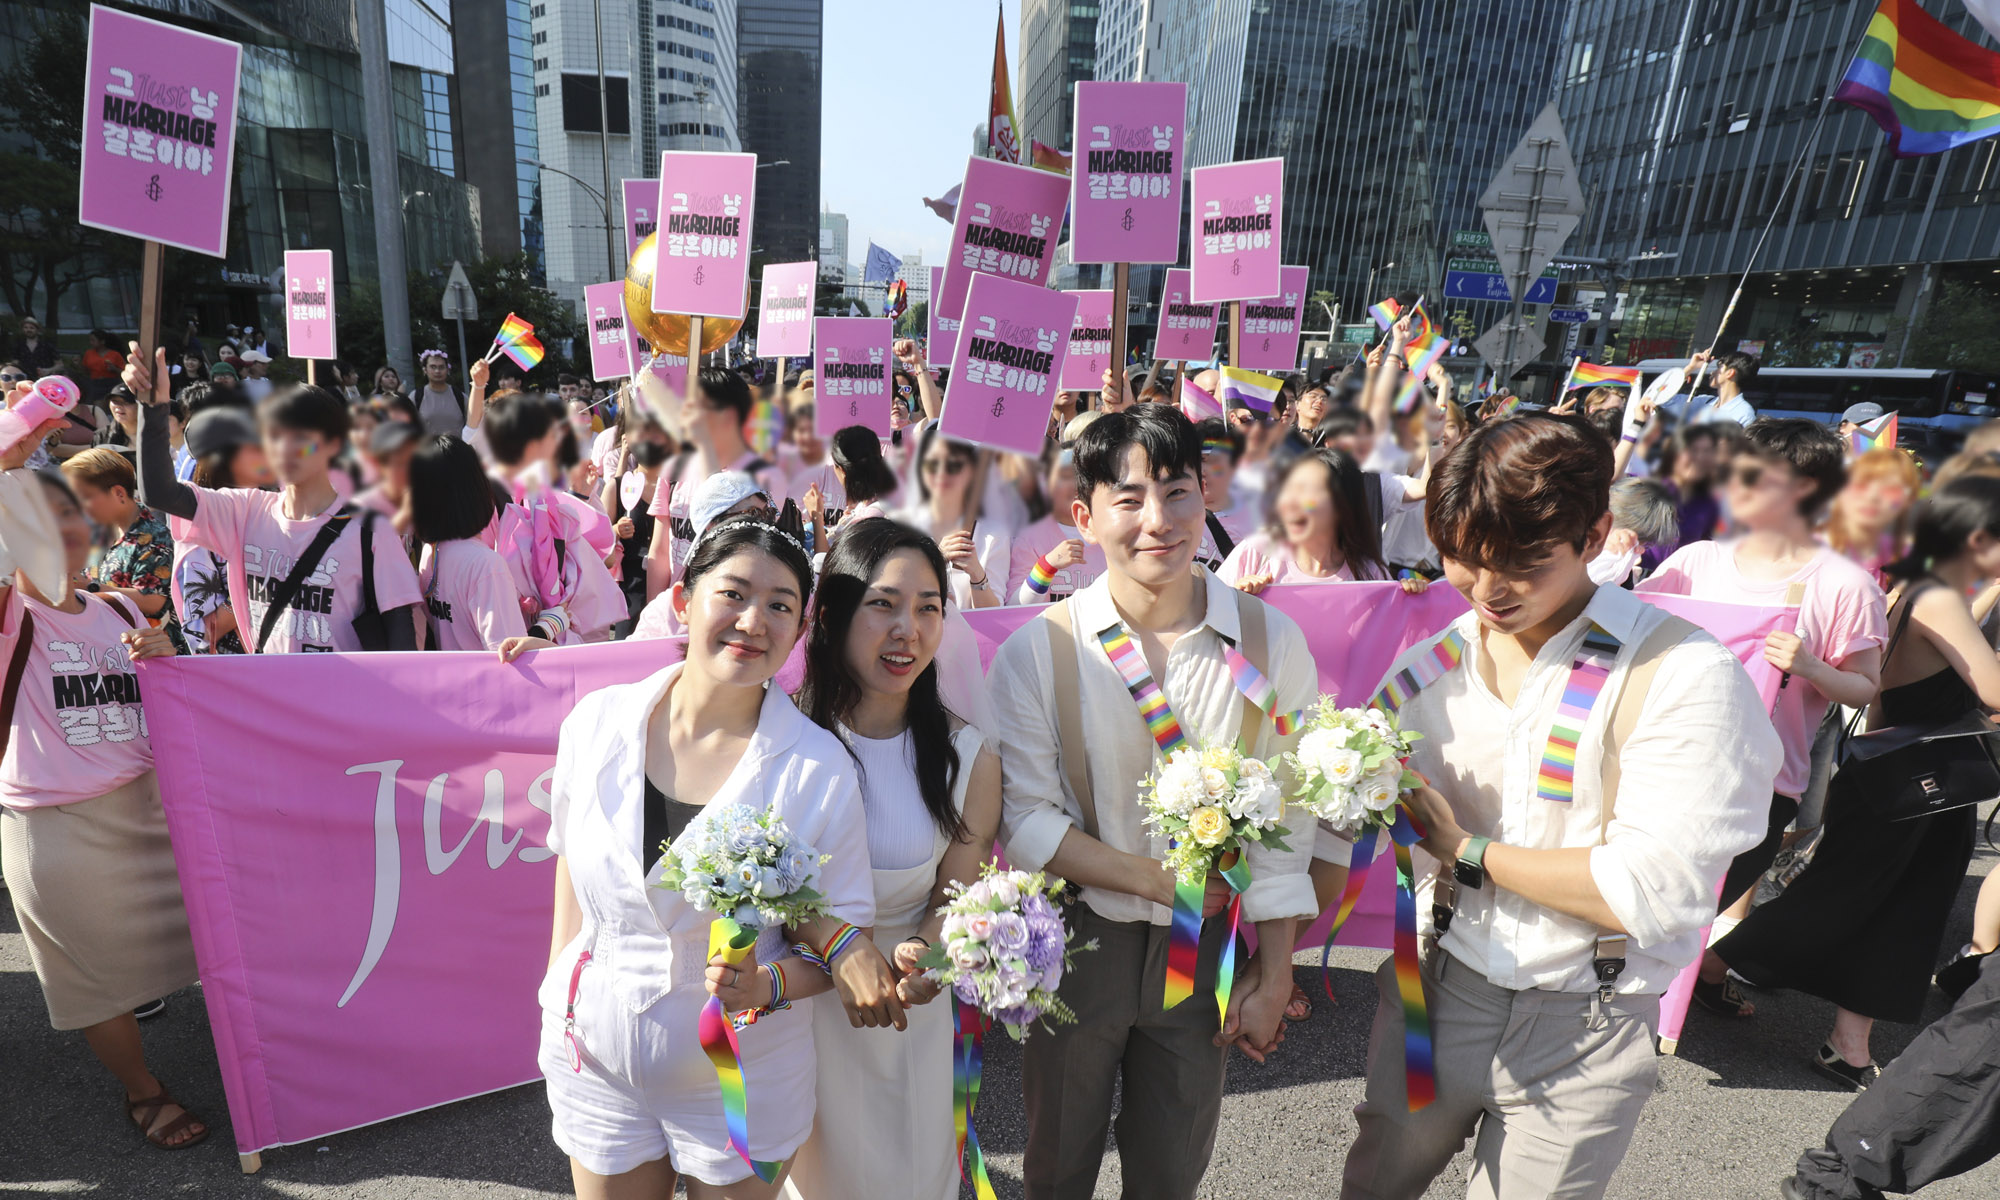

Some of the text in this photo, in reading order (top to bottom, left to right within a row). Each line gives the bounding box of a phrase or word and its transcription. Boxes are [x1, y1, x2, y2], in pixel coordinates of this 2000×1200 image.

[105, 67, 135, 97] 그
[190, 87, 219, 120] 냥
[103, 94, 217, 149] MARRIAGE
[103, 122, 213, 176] 결혼이야
[1089, 125, 1112, 148] 그
[1152, 125, 1174, 151] 냥
[1088, 149, 1172, 174] MARRIAGE
[1088, 174, 1171, 199] 결혼이야
[670, 193, 688, 212] 그
[723, 193, 742, 216] 냥
[1204, 200, 1221, 218] 그
[1254, 193, 1272, 214] 냥
[669, 214, 740, 237] MARRIAGE
[970, 202, 991, 224] 그
[1030, 213, 1052, 238] 냥
[1203, 213, 1272, 236] MARRIAGE
[668, 234, 738, 259] 결혼이야
[964, 223, 1047, 259] MARRIAGE
[1204, 231, 1271, 255] 결혼이야
[962, 244, 1040, 280] 결혼이야
[1487, 276, 1505, 288] 을지
[291, 292, 326, 305] MARRIAGE
[766, 297, 808, 310] MARRIAGE
[291, 305, 327, 321] 결혼이야
[766, 309, 806, 324] 결혼이야
[1168, 303, 1214, 318] MARRIAGE
[1245, 305, 1297, 320] MARRIAGE
[595, 316, 624, 332] MARRI
[974, 315, 996, 338] 그
[1036, 327, 1059, 352] 냥
[1070, 327, 1111, 341] MARRIA
[1167, 316, 1211, 330] 결혼이야
[1244, 318, 1294, 334] 결혼이야
[824, 347, 840, 362] 그
[869, 347, 884, 364] 냥
[968, 337, 1054, 375] MARRIAGE
[824, 362, 885, 379] MARRIAGE
[966, 358, 1047, 396] 결혼이야
[824, 378, 884, 396] 결혼이야
